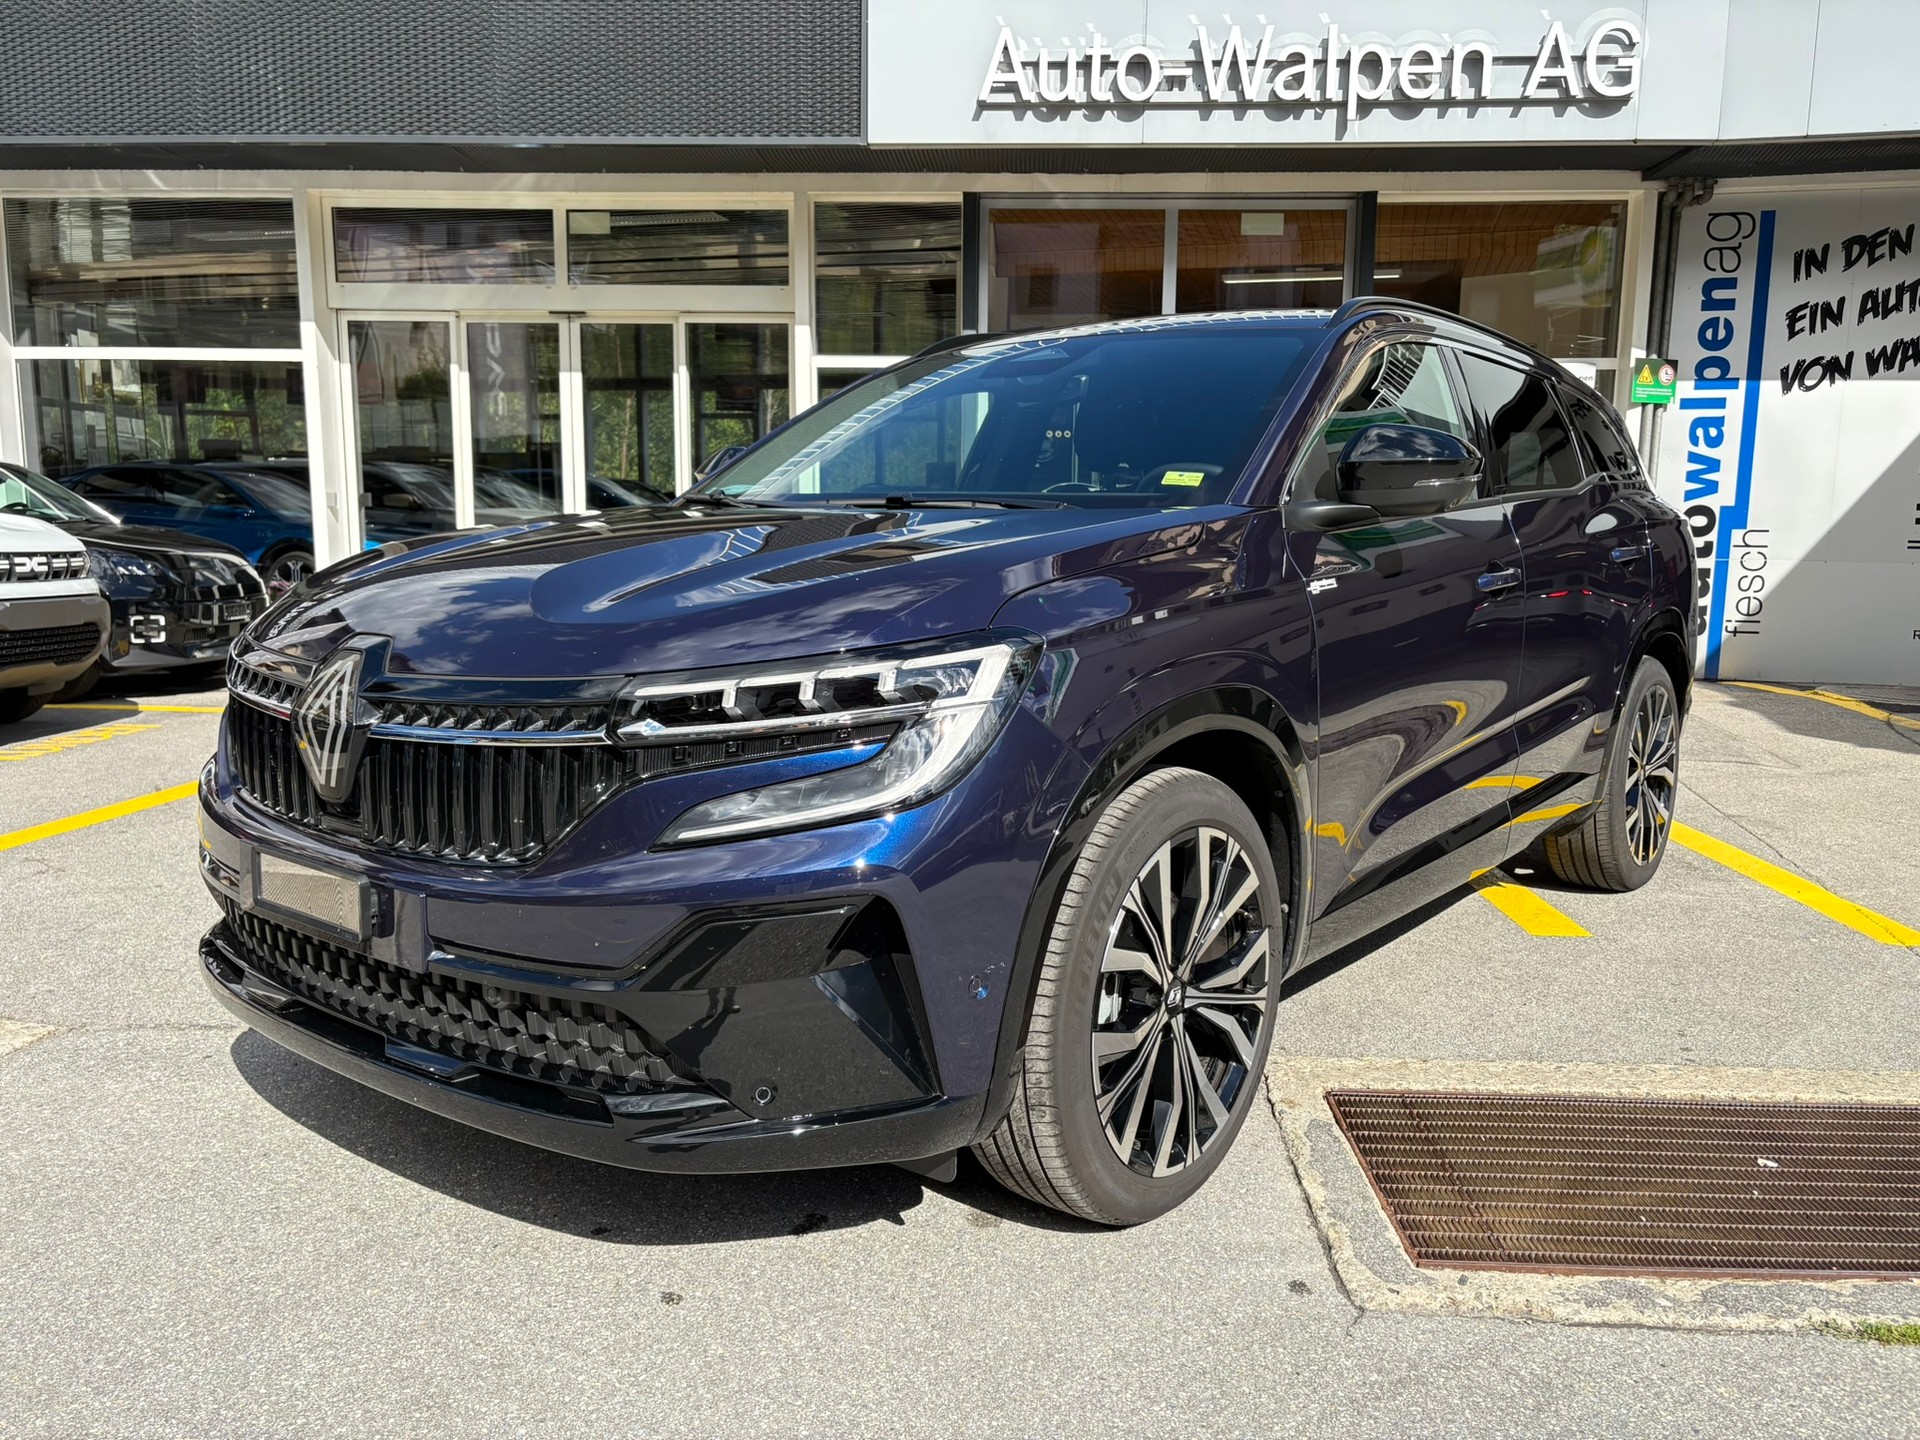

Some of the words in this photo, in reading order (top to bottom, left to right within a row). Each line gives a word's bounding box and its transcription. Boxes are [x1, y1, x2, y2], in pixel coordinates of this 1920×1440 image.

[983, 24, 1491, 121] Auto-Walpen
[1523, 20, 1641, 98] AG
[1793, 243, 1830, 283] IN
[1841, 223, 1915, 273] DEN
[1785, 296, 1846, 342] EIN
[1857, 278, 1920, 326] AUT
[1780, 350, 1854, 397] VON
[1725, 529, 1770, 638] fiesch
